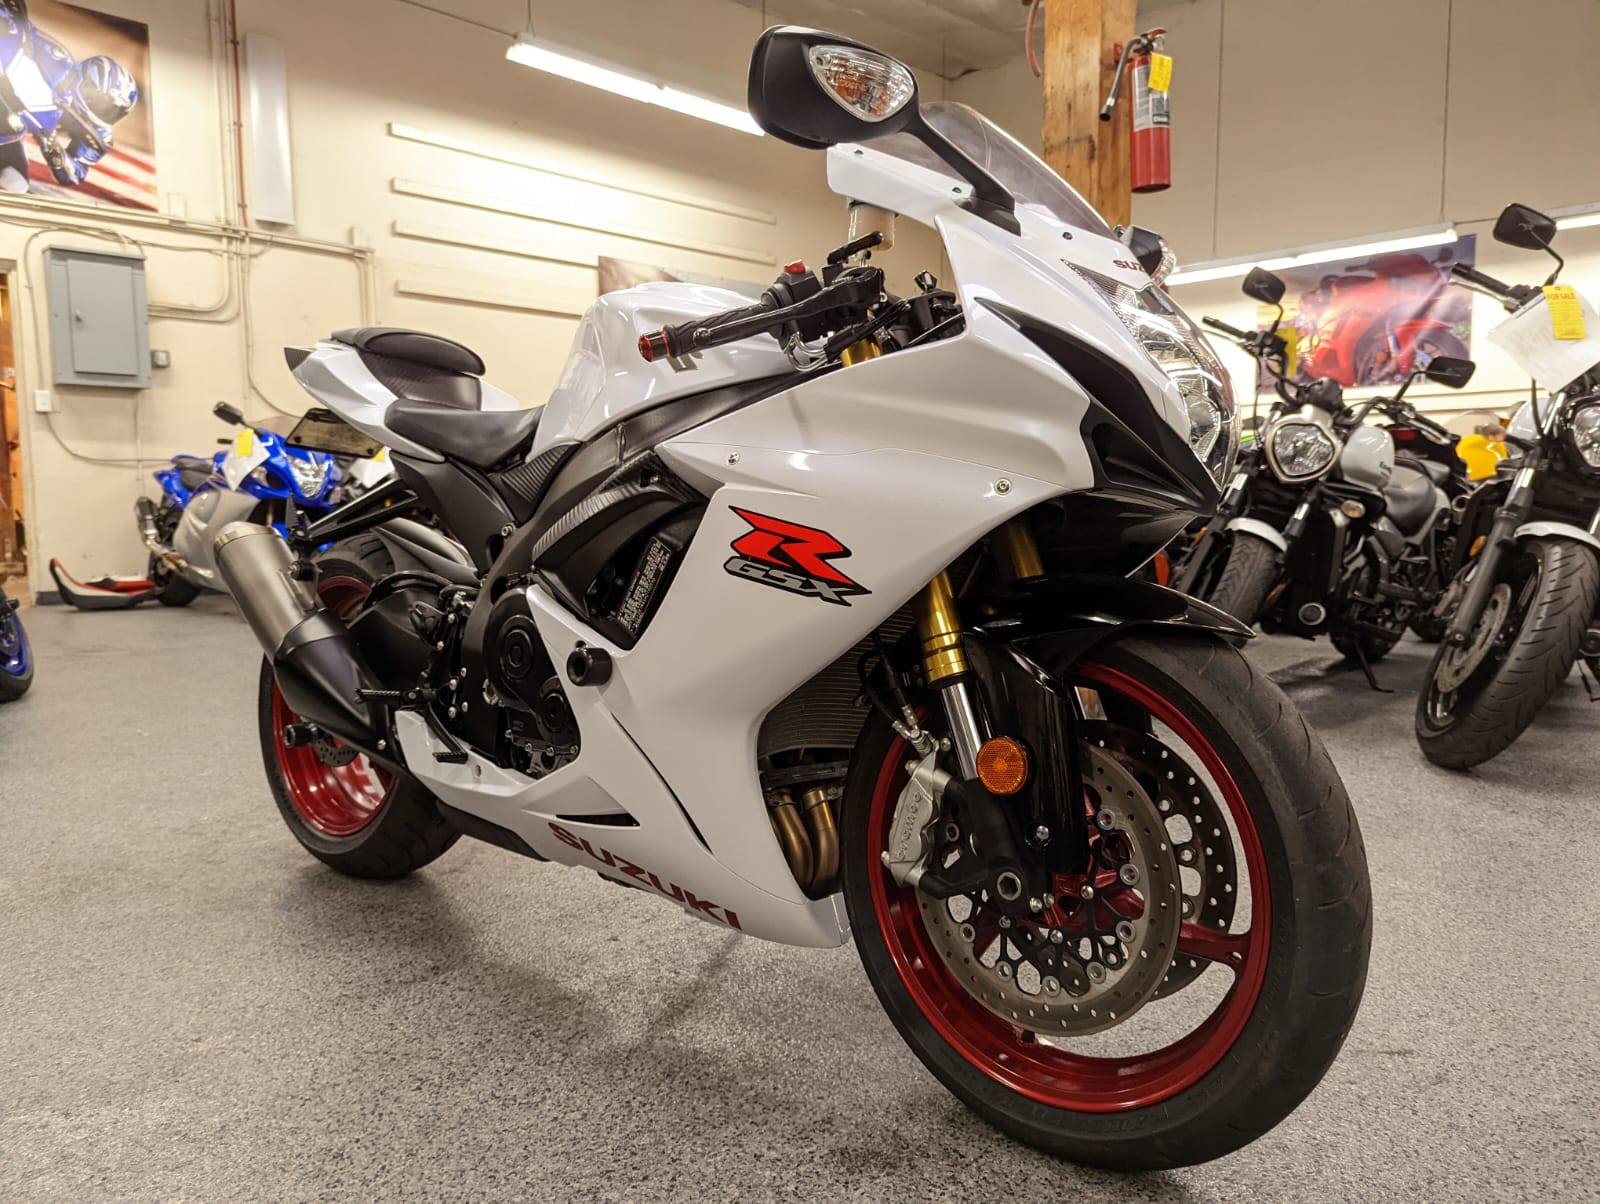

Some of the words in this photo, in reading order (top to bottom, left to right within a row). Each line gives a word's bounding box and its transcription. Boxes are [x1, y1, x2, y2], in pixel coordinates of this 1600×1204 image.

[1113, 259, 1146, 273] SUZ
[724, 556, 864, 606] GSX
[548, 821, 742, 930] SUZUKI
